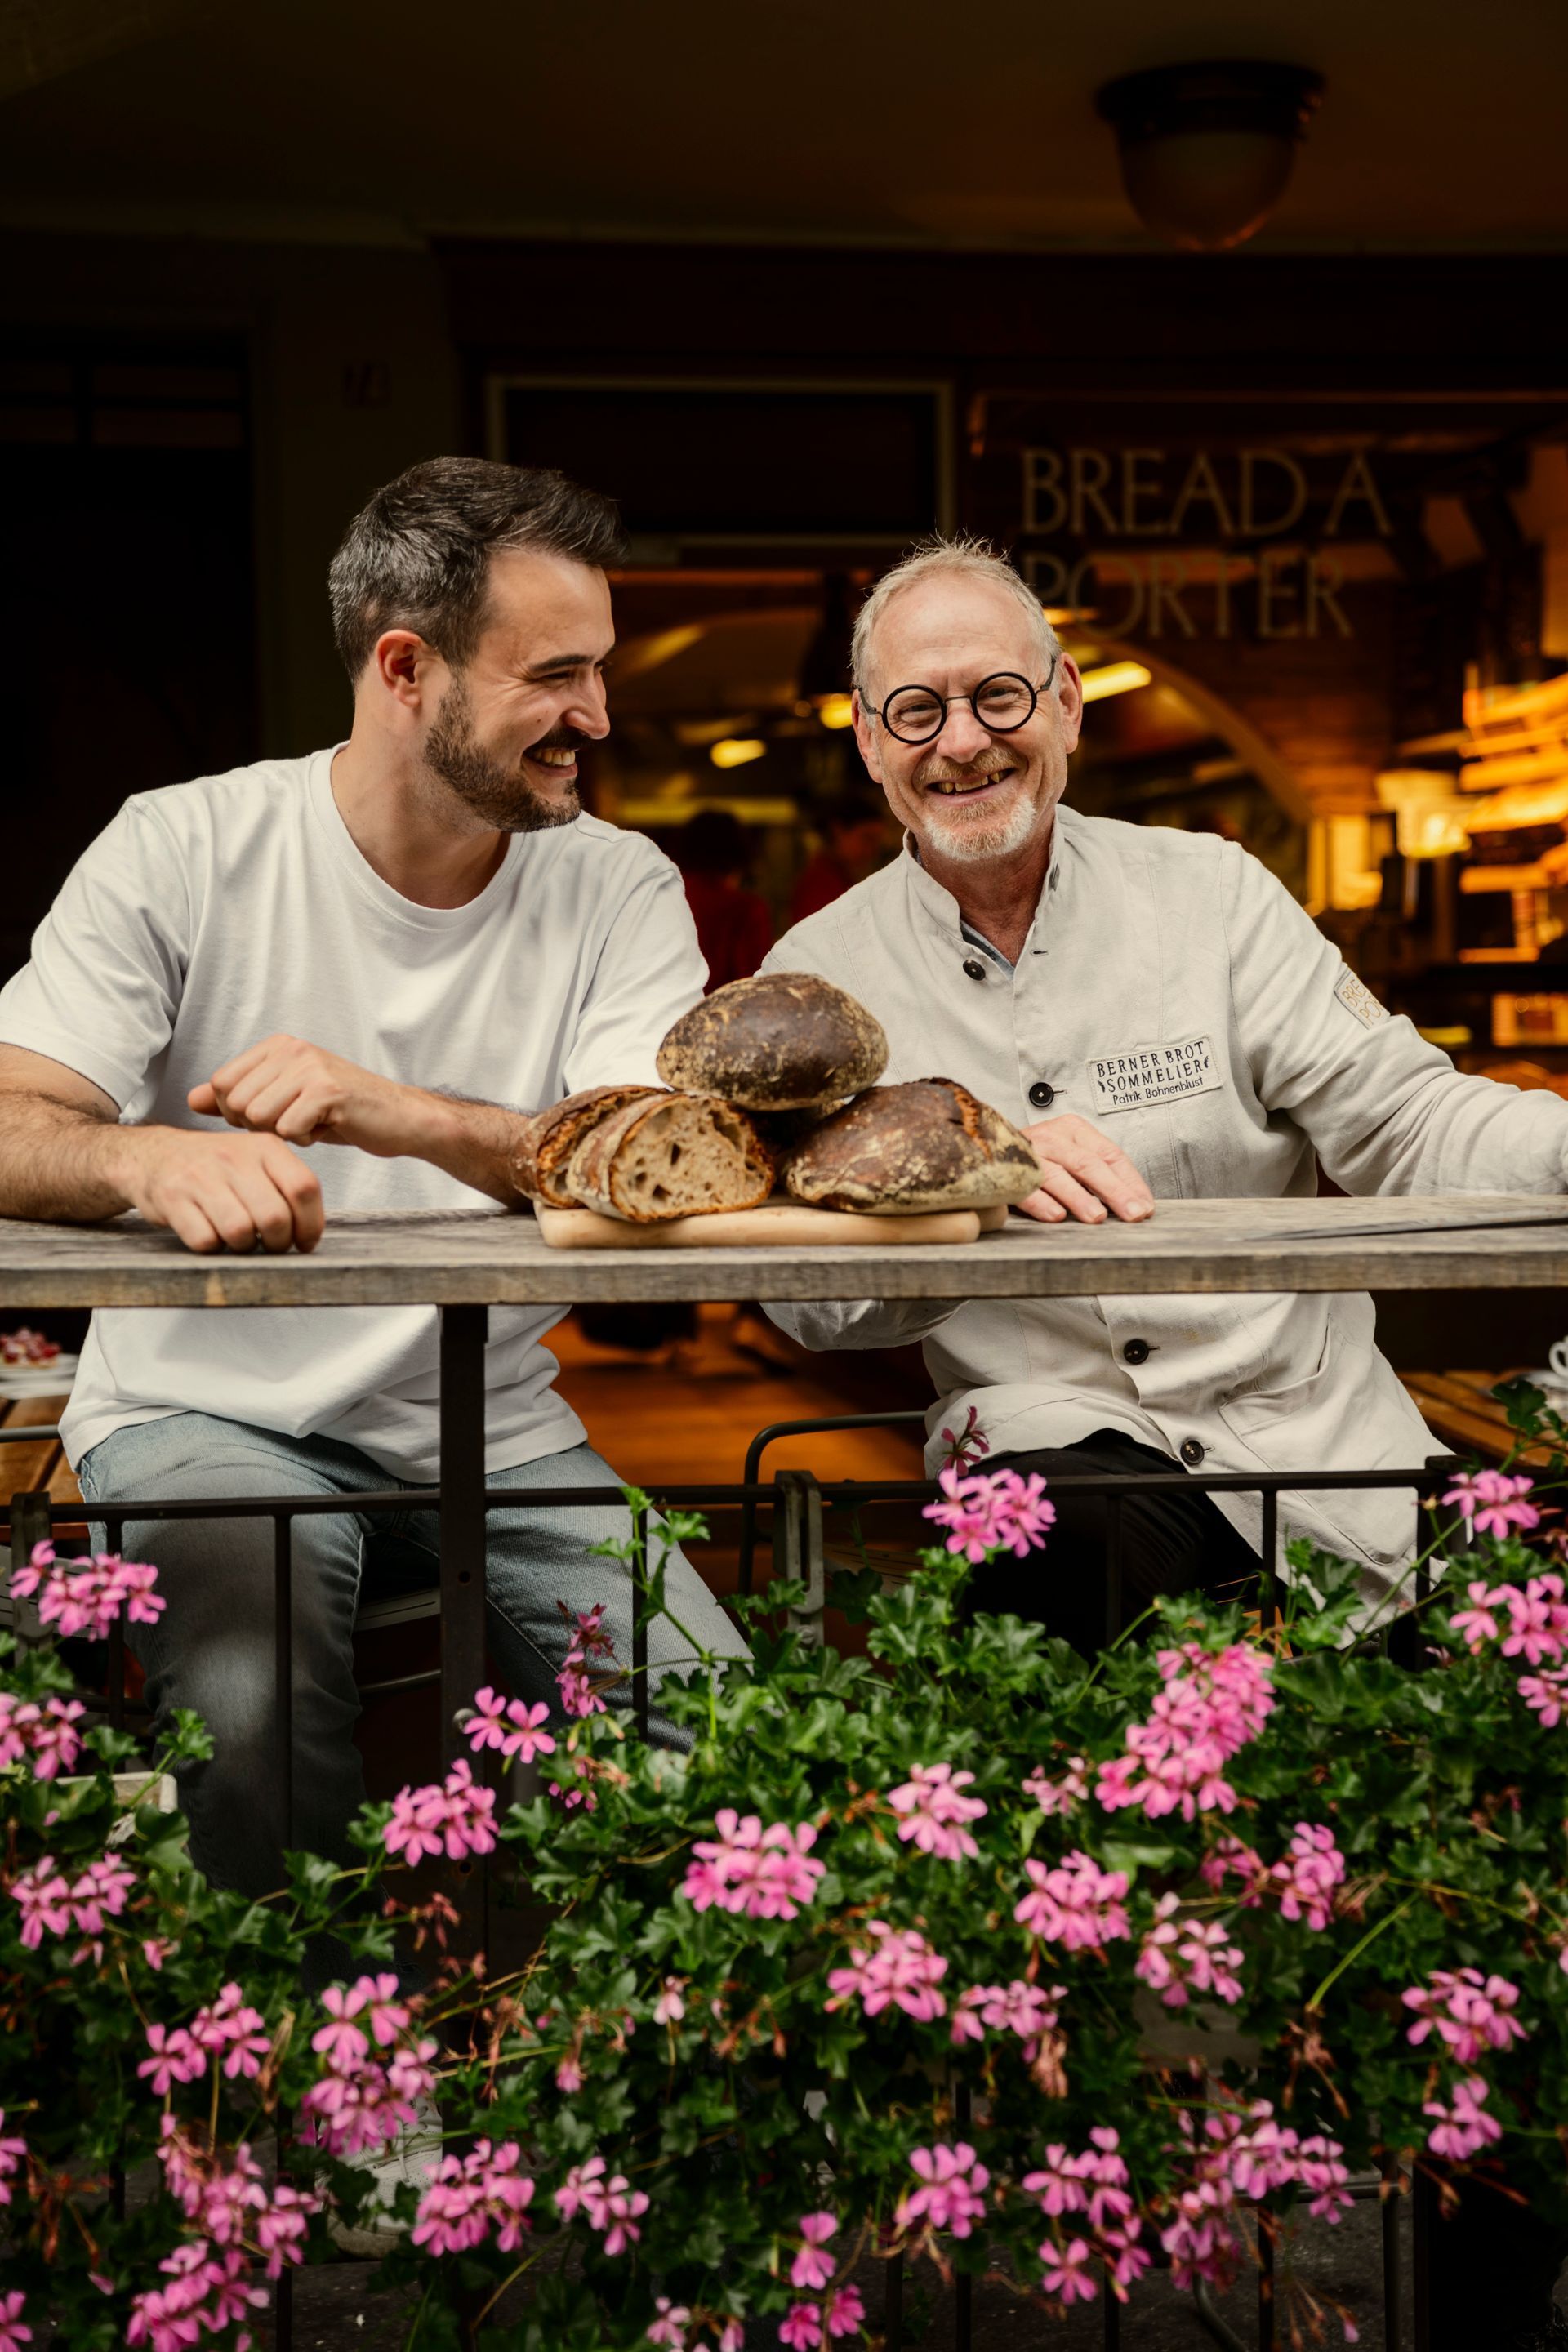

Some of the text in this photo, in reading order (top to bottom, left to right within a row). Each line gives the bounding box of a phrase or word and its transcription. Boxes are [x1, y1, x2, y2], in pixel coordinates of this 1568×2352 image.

[1022, 447, 1397, 537] BREAD A
[1022, 550, 1353, 638] PORTER
[1096, 1040, 1204, 1078] BERNER BROT
[1107, 1059, 1203, 1093] SOMMELIER
[1112, 1076, 1204, 1105] Patrik Bohnenblust
